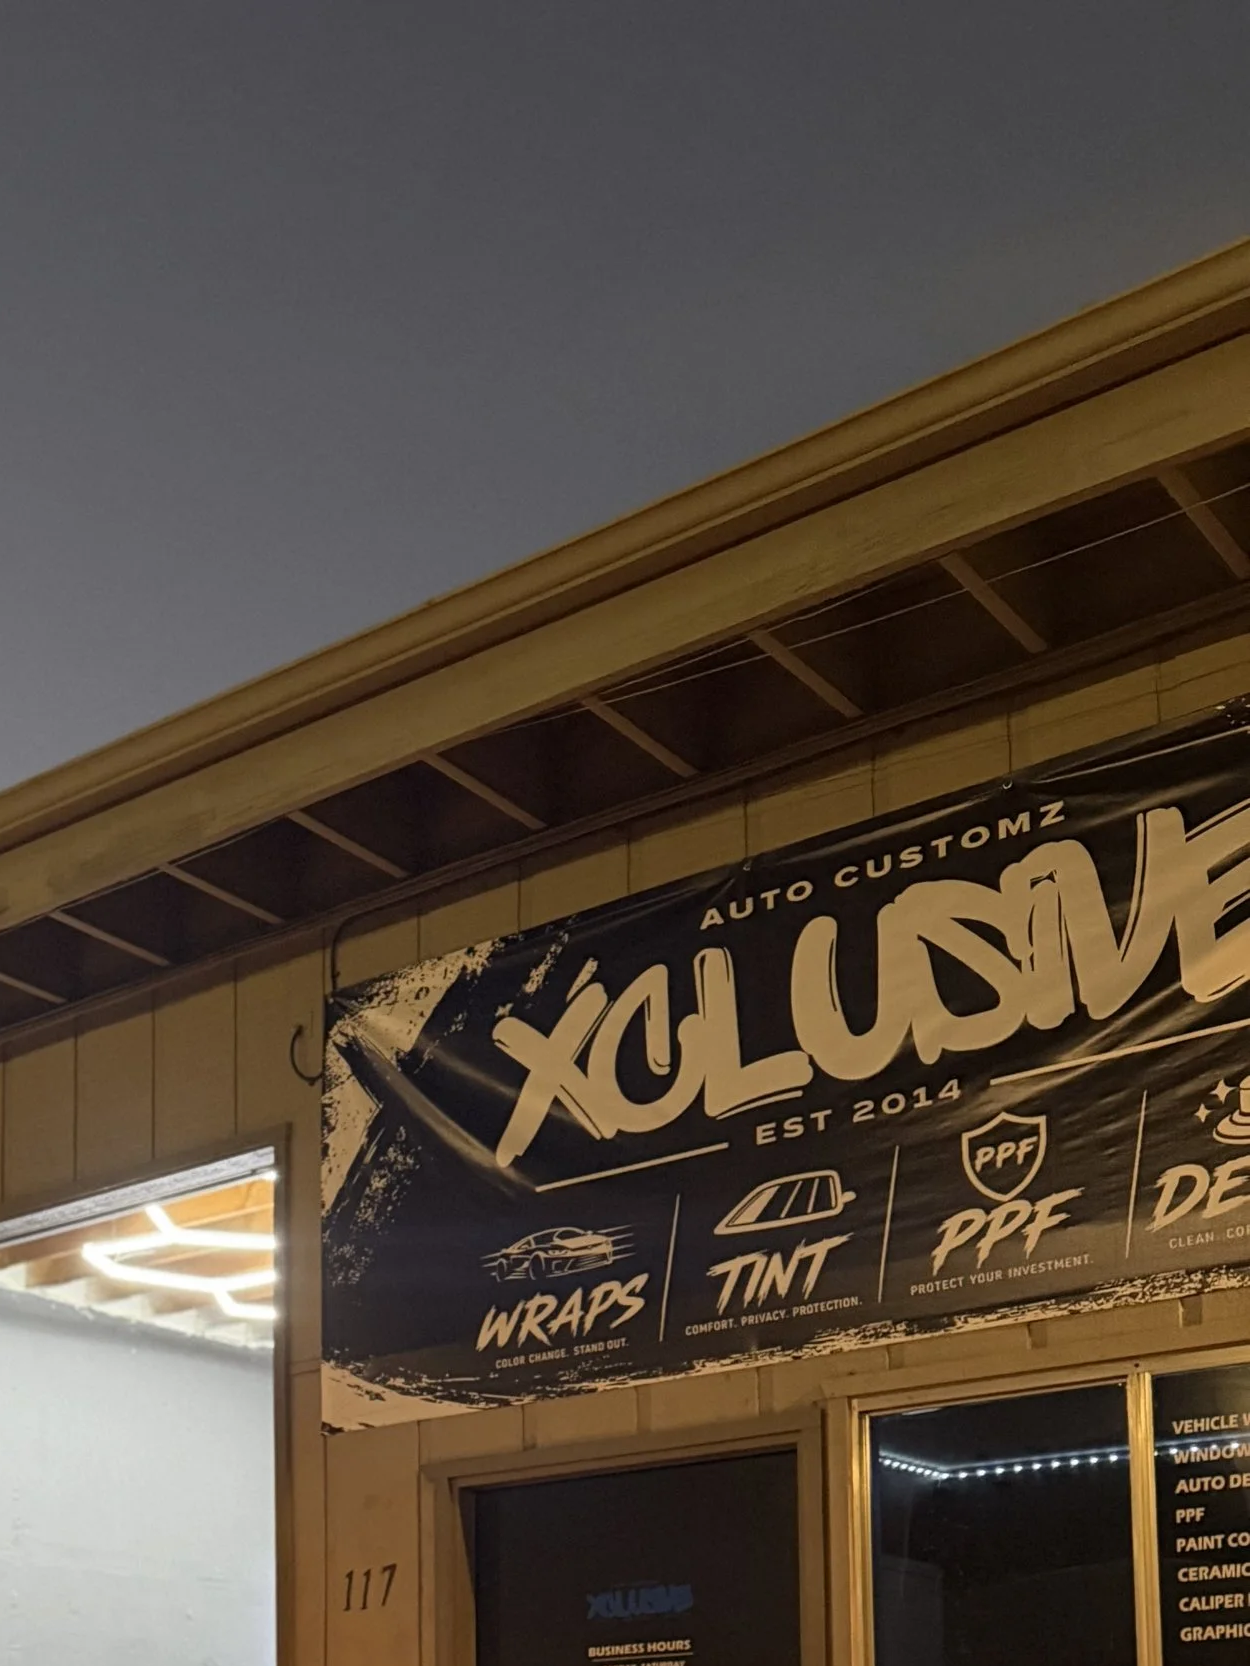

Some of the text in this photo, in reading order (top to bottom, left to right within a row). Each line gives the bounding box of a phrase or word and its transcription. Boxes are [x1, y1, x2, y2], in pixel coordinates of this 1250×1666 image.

[700, 800, 1066, 930] AUTO CUSTOMZ
[755, 1078, 962, 1146] EST 2014
[974, 1135, 1039, 1173] PPF
[930, 1187, 1086, 1277] PPF
[706, 1232, 855, 1316] TINT
[910, 1253, 1095, 1296] PROTECT YOUR INVESTMENT.
[475, 1272, 650, 1352] WRAPS
[685, 1296, 863, 1337] COMFORT. PRIVACY. PROTECTION.
[495, 1336, 630, 1370] COLOR CHANGE. STAND OUT.
[1172, 1413, 1239, 1435] VEHICLE
[1175, 1475, 1226, 1494] AUTO
[1176, 1507, 1205, 1523] PPF
[1176, 1534, 1224, 1553] PAINT
[343, 1563, 397, 1612] 117
[1177, 1562, 1250, 1582] CERAMIC
[1178, 1593, 1244, 1612] CALIPER
[588, 1639, 691, 1658] BUSINESS HOURS
